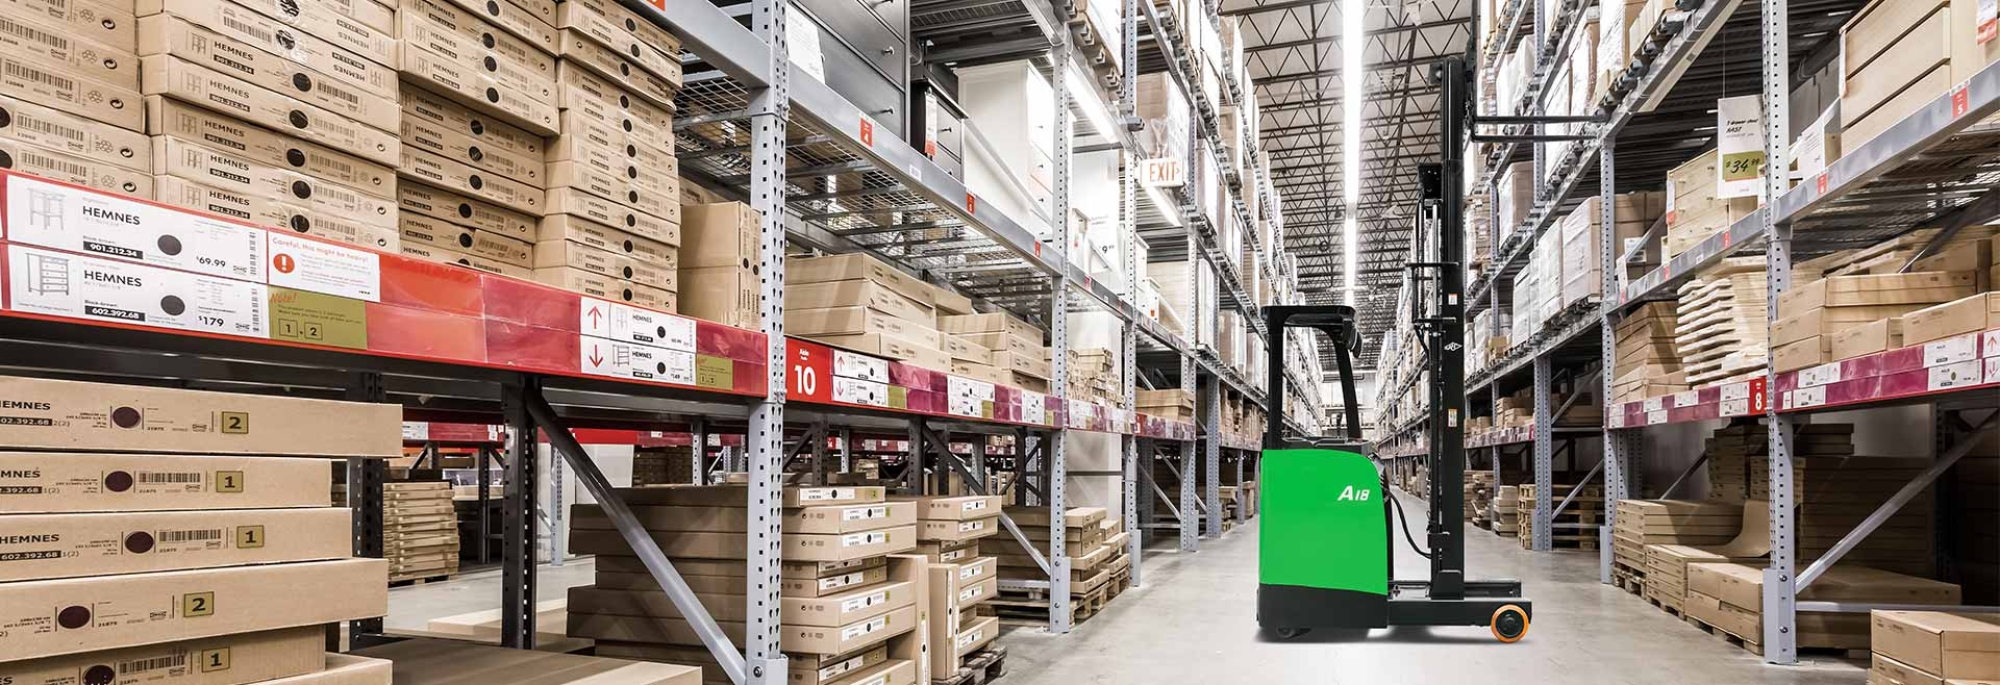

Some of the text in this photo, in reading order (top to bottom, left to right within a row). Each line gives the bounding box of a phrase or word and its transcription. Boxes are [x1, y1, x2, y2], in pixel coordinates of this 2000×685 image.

[214, 41, 254, 61] HEMNES
[209, 80, 250, 99] HEMNES
[204, 120, 245, 138] HEMNES
[209, 154, 250, 171] HEMNES
[415, 156, 441, 171] HEMNES
[1150, 162, 1177, 182] EXIT
[209, 191, 250, 206] HEMNES
[83, 206, 141, 226] HEMNES
[90, 243, 138, 258] 901.212.34
[403, 246, 430, 257] HEMNES
[196, 257, 226, 268] $69.99
[84, 270, 142, 288] HEMNES
[92, 307, 140, 321] 602.392.68
[198, 316, 224, 327] $179
[309, 326, 318, 337] 2
[631, 352, 652, 362] HEMNES
[794, 364, 816, 396] 10
[1755, 392, 1762, 411] 8
[228, 416, 242, 430] 2
[225, 475, 235, 488] 1
[1338, 485, 1370, 501] A18
[0, 534, 60, 544] HEMNES
[245, 530, 255, 544] 1
[1, 551, 58, 560] 602.392.68
[192, 597, 206, 612] 2
[210, 653, 220, 667] 1
